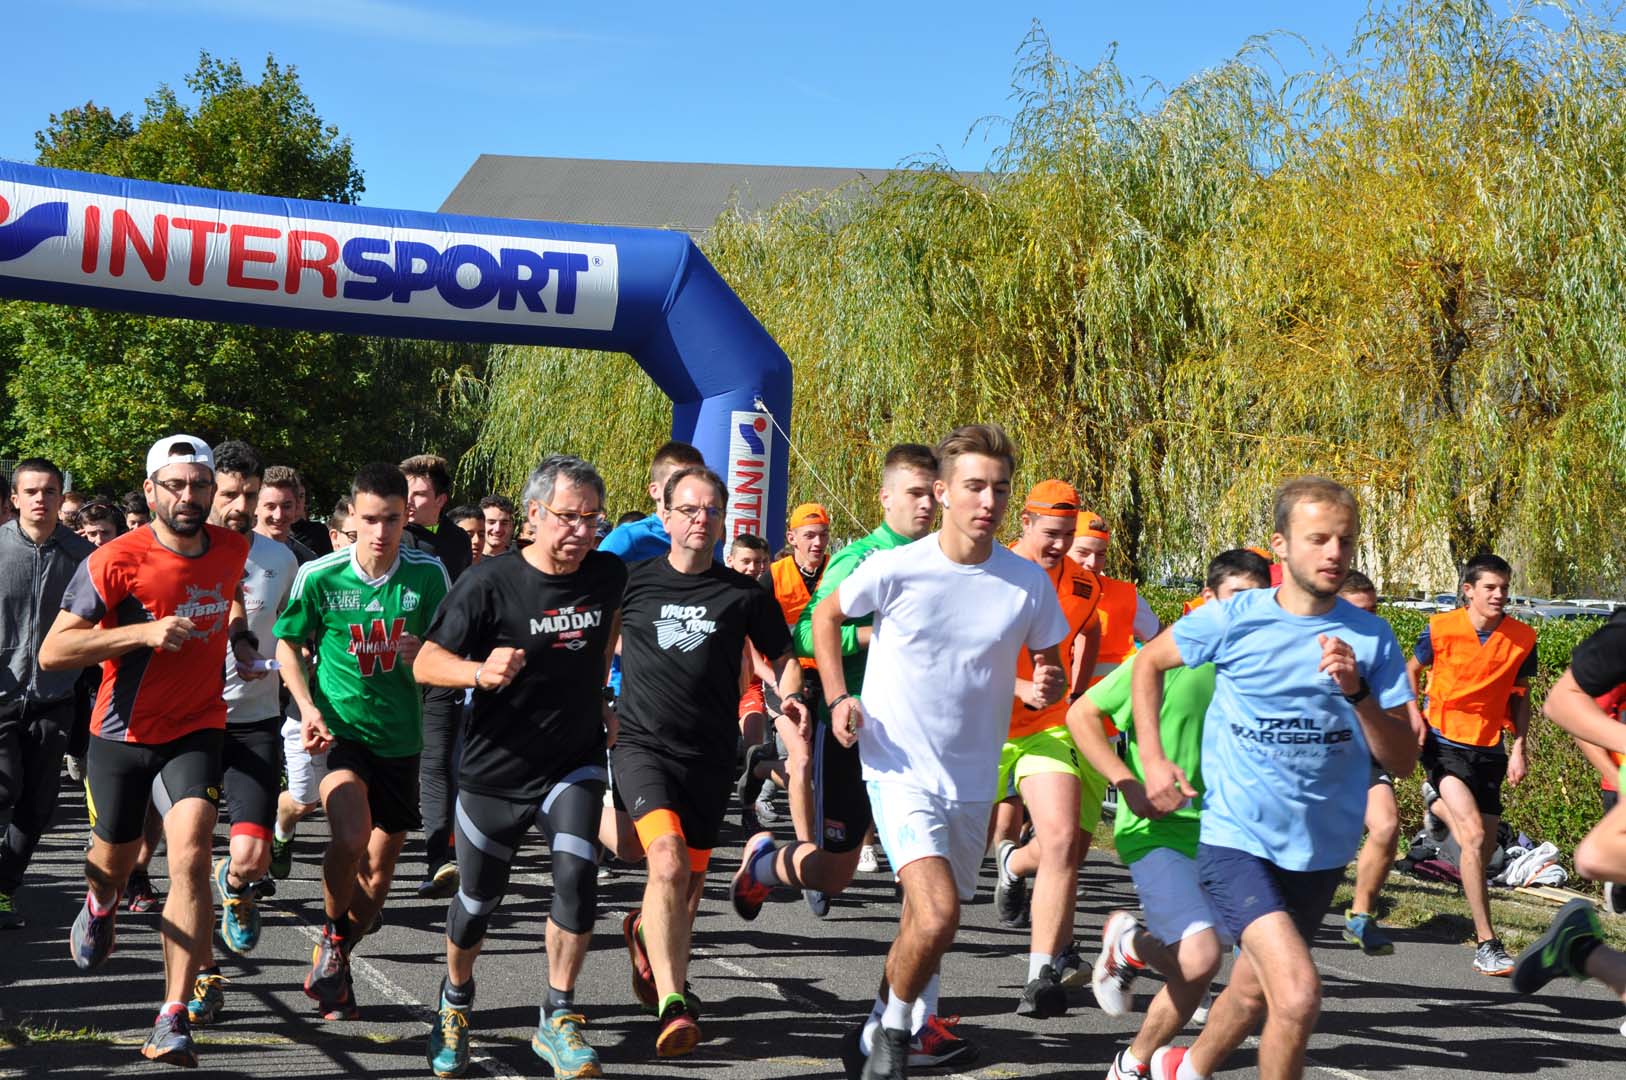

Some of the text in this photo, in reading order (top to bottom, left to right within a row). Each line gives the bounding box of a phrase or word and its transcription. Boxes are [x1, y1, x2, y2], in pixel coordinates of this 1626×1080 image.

[81, 204, 589, 315] INTERSPORT
[559, 606, 576, 615] THE
[660, 604, 707, 620] VALDO
[530, 610, 602, 635] MUD DAY
[685, 619, 717, 633] TRAIL
[1255, 717, 1321, 731] TRAIL
